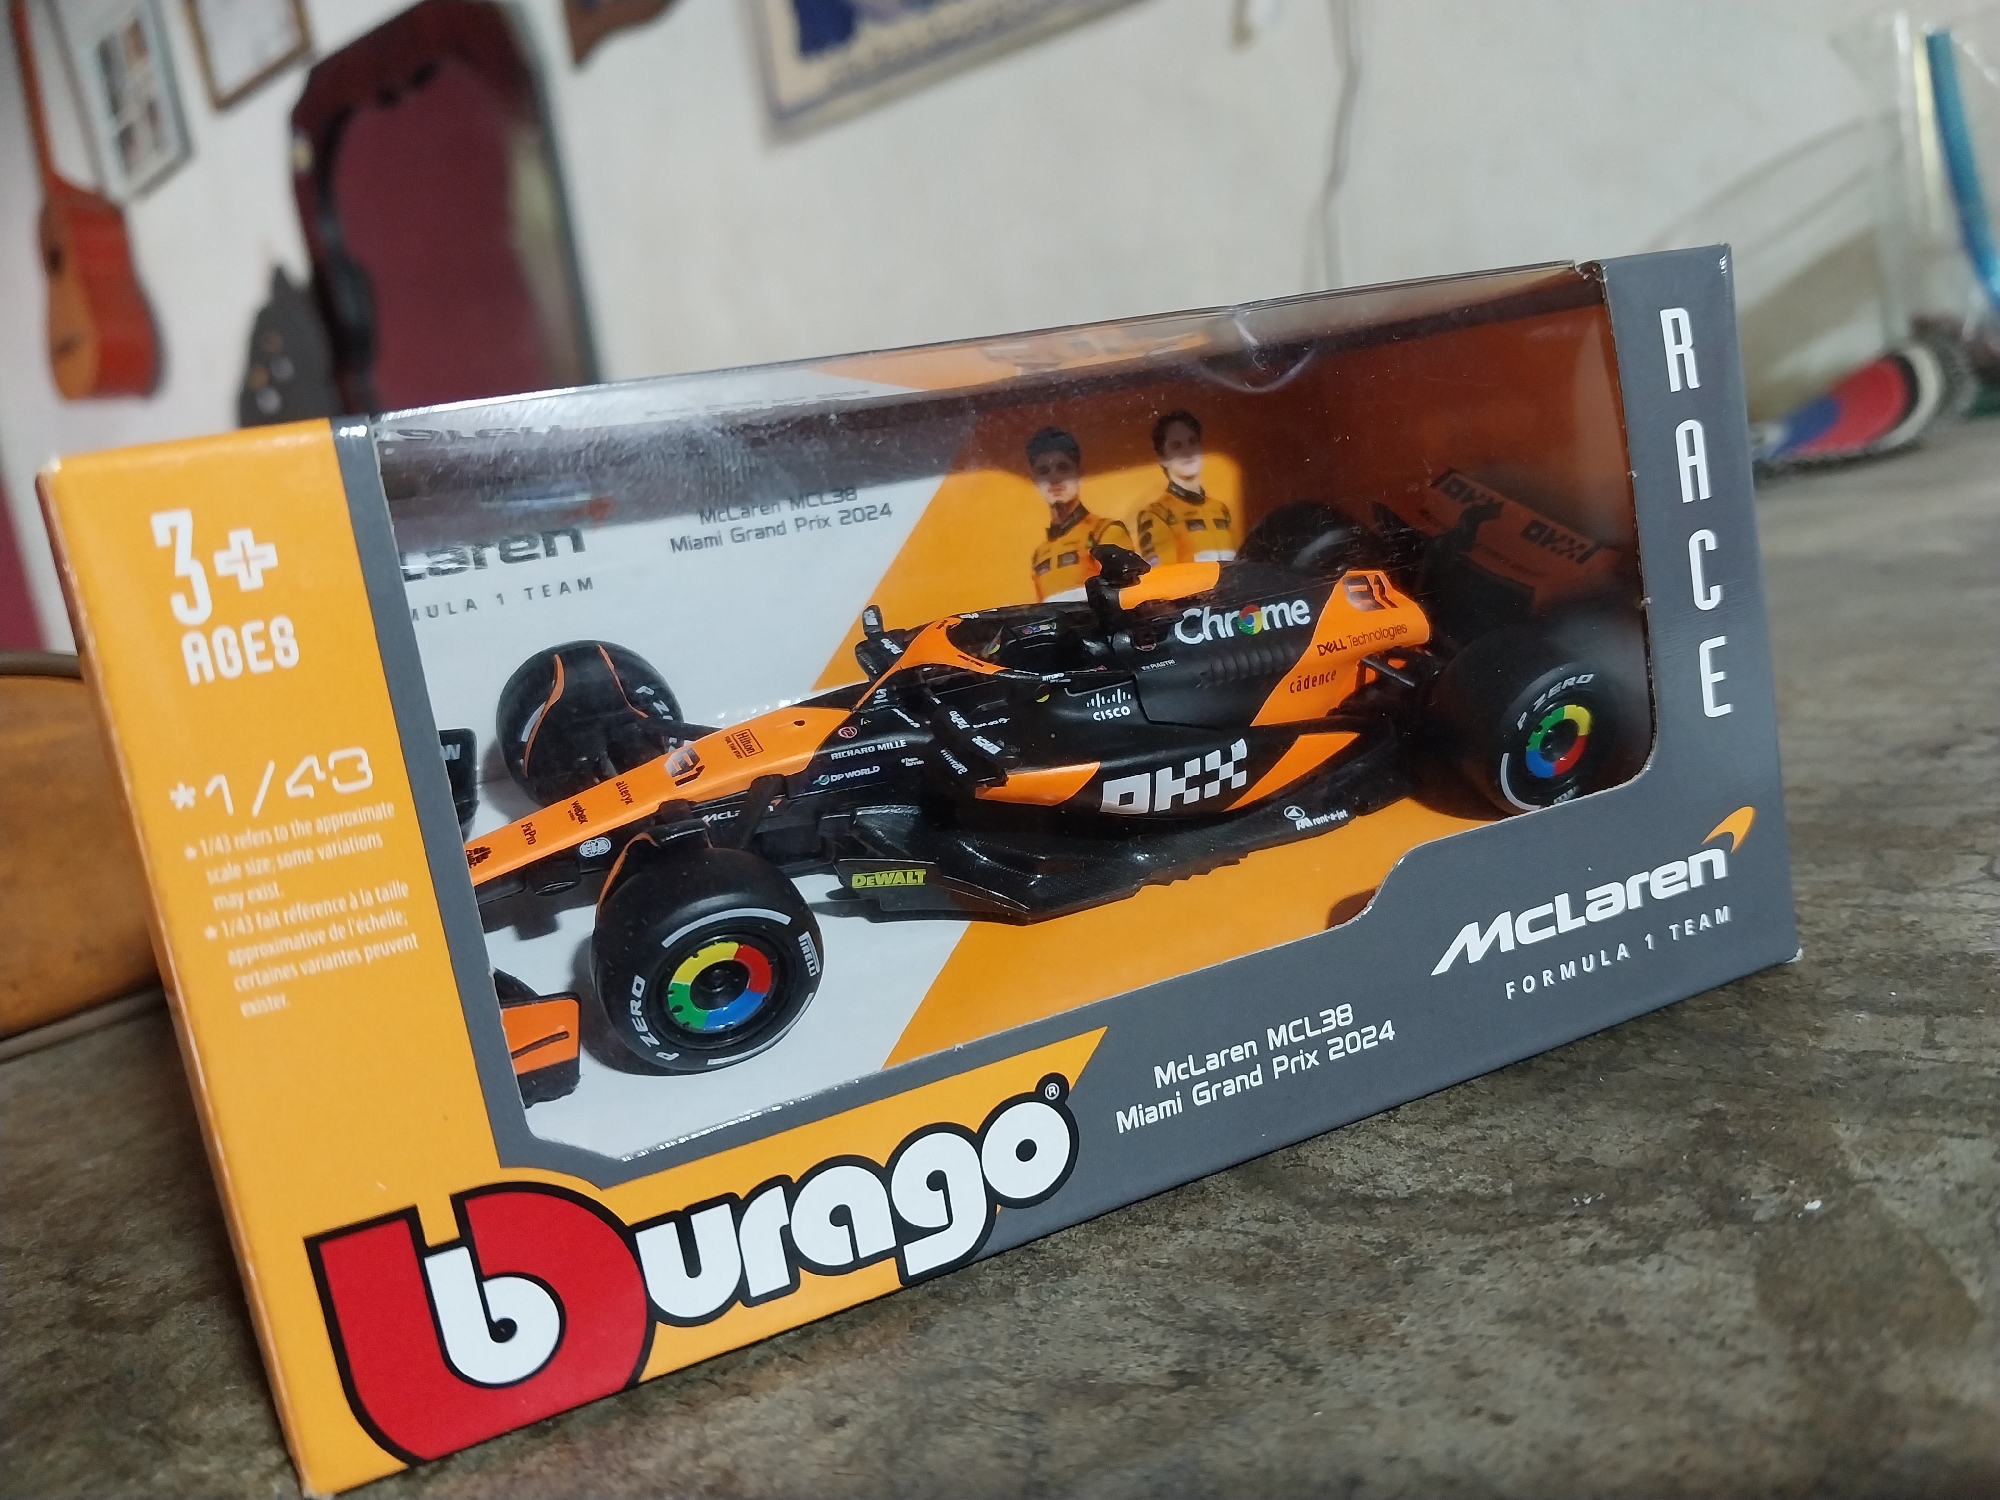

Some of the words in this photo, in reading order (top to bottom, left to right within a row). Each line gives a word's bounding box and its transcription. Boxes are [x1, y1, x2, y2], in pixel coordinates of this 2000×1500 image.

[669, 530, 723, 553] Miami
[730, 520, 787, 544] Grand
[794, 513, 832, 534] Prix
[837, 503, 893, 526] 2024
[1660, 307, 1733, 719] RACE
[151, 508, 278, 626] 3+
[497, 592, 505, 606] 1
[524, 577, 594, 601] TEAM
[1174, 599, 1311, 645] Chrome
[1316, 638, 1348, 657] DELL
[1347, 623, 1408, 649] Technologies
[181, 615, 299, 686] AGES
[1533, 673, 1596, 713] ZERO
[830, 745, 876, 761] RICHARD
[877, 739, 908, 752] MILLE
[845, 765, 881, 779] WORLD
[1100, 738, 1248, 815] OKX
[274, 824, 289, 843] to
[290, 818, 313, 838] the
[316, 801, 395, 836] approximate
[316, 832, 384, 861] variations
[375, 879, 410, 904] taille
[1431, 847, 1729, 977] McLaren
[299, 947, 363, 977] variantes
[363, 932, 420, 965] peuvent
[328, 922, 347, 942] de
[1504, 942, 1631, 1001] FORMULA
[1644, 932, 1656, 951] 1
[1668, 904, 1731, 942] TEAM
[629, 974, 661, 1048] ZERO
[1153, 1039, 1259, 1090] McLaren
[1266, 1002, 1355, 1051] MCL38
[1115, 1091, 1184, 1135] Miami
[1192, 1063, 1264, 1107] Grand
[1272, 1048, 1321, 1081] Prix
[1326, 1019, 1397, 1062] 2024
